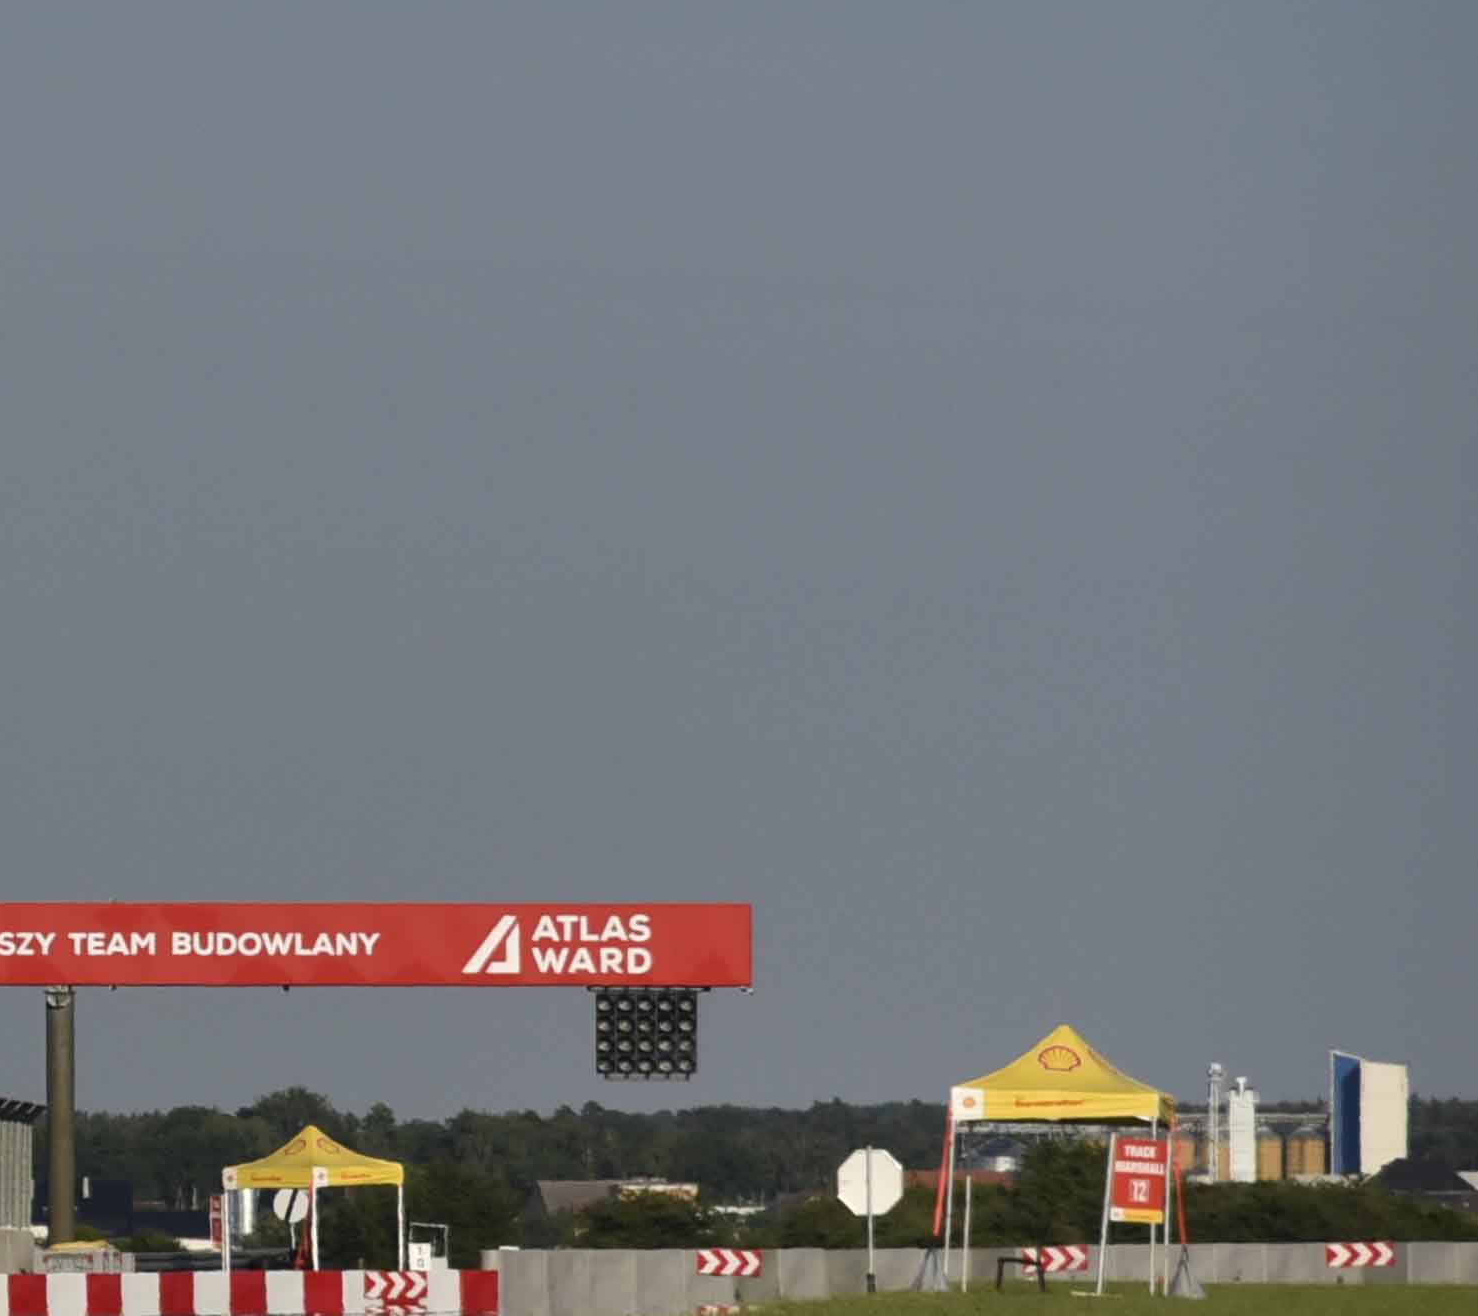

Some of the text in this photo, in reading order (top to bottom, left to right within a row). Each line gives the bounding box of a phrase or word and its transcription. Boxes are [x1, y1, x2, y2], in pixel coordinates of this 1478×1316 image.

[531, 914, 652, 942] ATLAS
[68, 932, 155, 956] TEAM
[172, 932, 380, 956] BUDOWLANY
[531, 947, 653, 974] WARD
